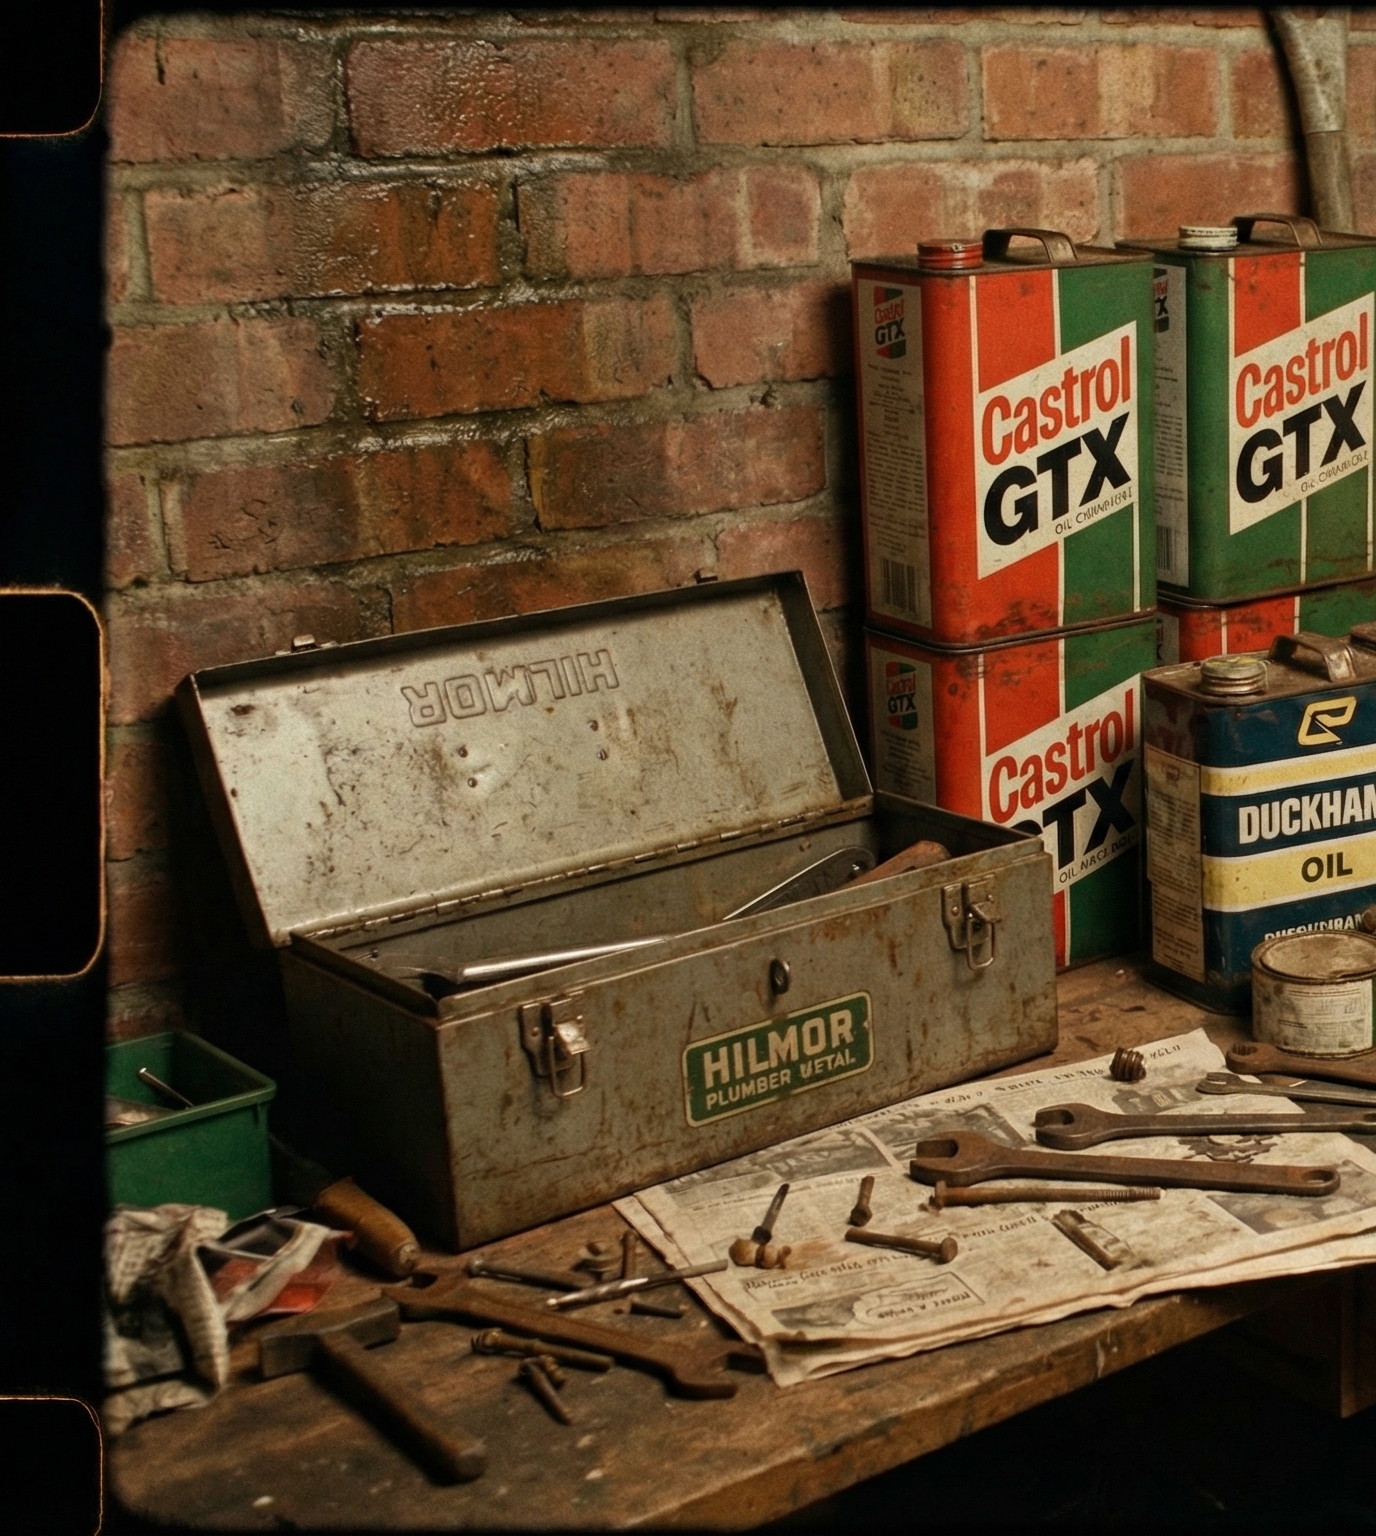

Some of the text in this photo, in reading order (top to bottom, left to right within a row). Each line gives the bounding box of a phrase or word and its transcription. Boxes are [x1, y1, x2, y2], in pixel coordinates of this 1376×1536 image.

[875, 317, 906, 345] GTX
[1235, 311, 1368, 429] Castrol
[981, 335, 1131, 466] Castrol
[983, 411, 1132, 546] GTX
[1236, 380, 1367, 504] GTX
[400, 648, 620, 728] HILMOR
[888, 692, 916, 714] GTX
[988, 688, 1134, 824] Castrol
[1301, 852, 1353, 883] OIL
[703, 1009, 854, 1089] HILMOR
[706, 1069, 791, 1111] PLUMBER
